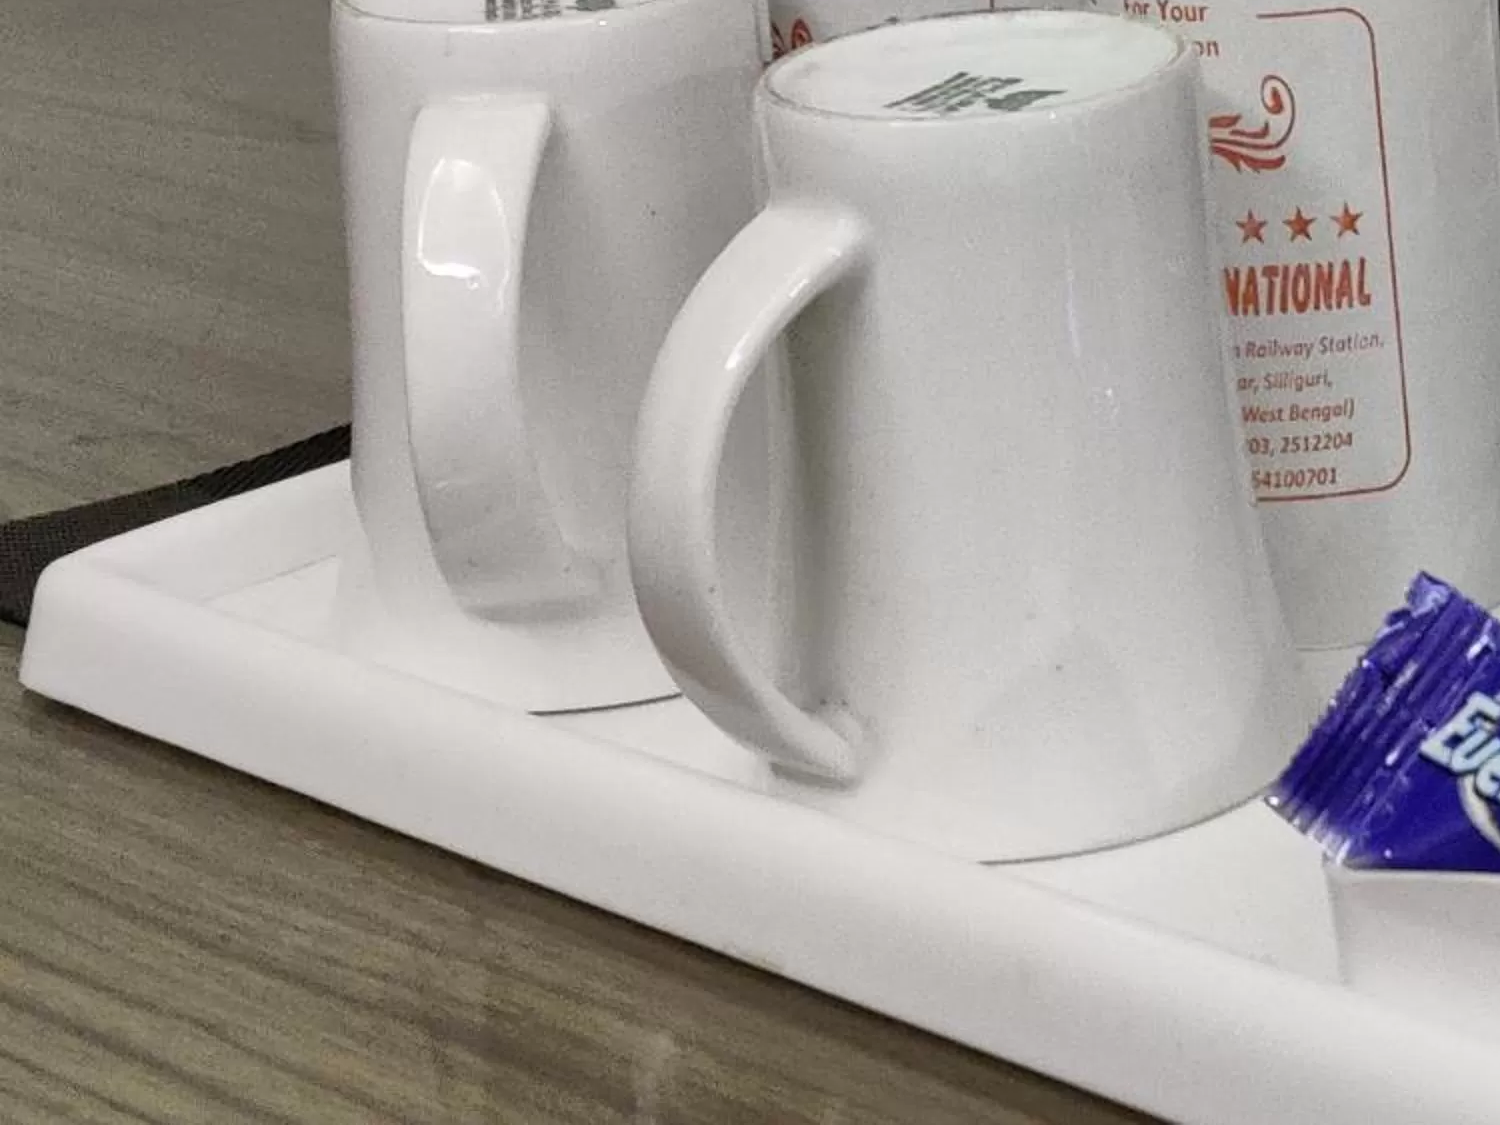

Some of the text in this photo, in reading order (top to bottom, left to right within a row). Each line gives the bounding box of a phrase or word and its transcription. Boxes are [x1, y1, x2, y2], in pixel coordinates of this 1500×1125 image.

[1245, 339, 1314, 359] Railway
[1289, 398, 1356, 422] Bengal)
[1280, 432, 1354, 454] 2512204
